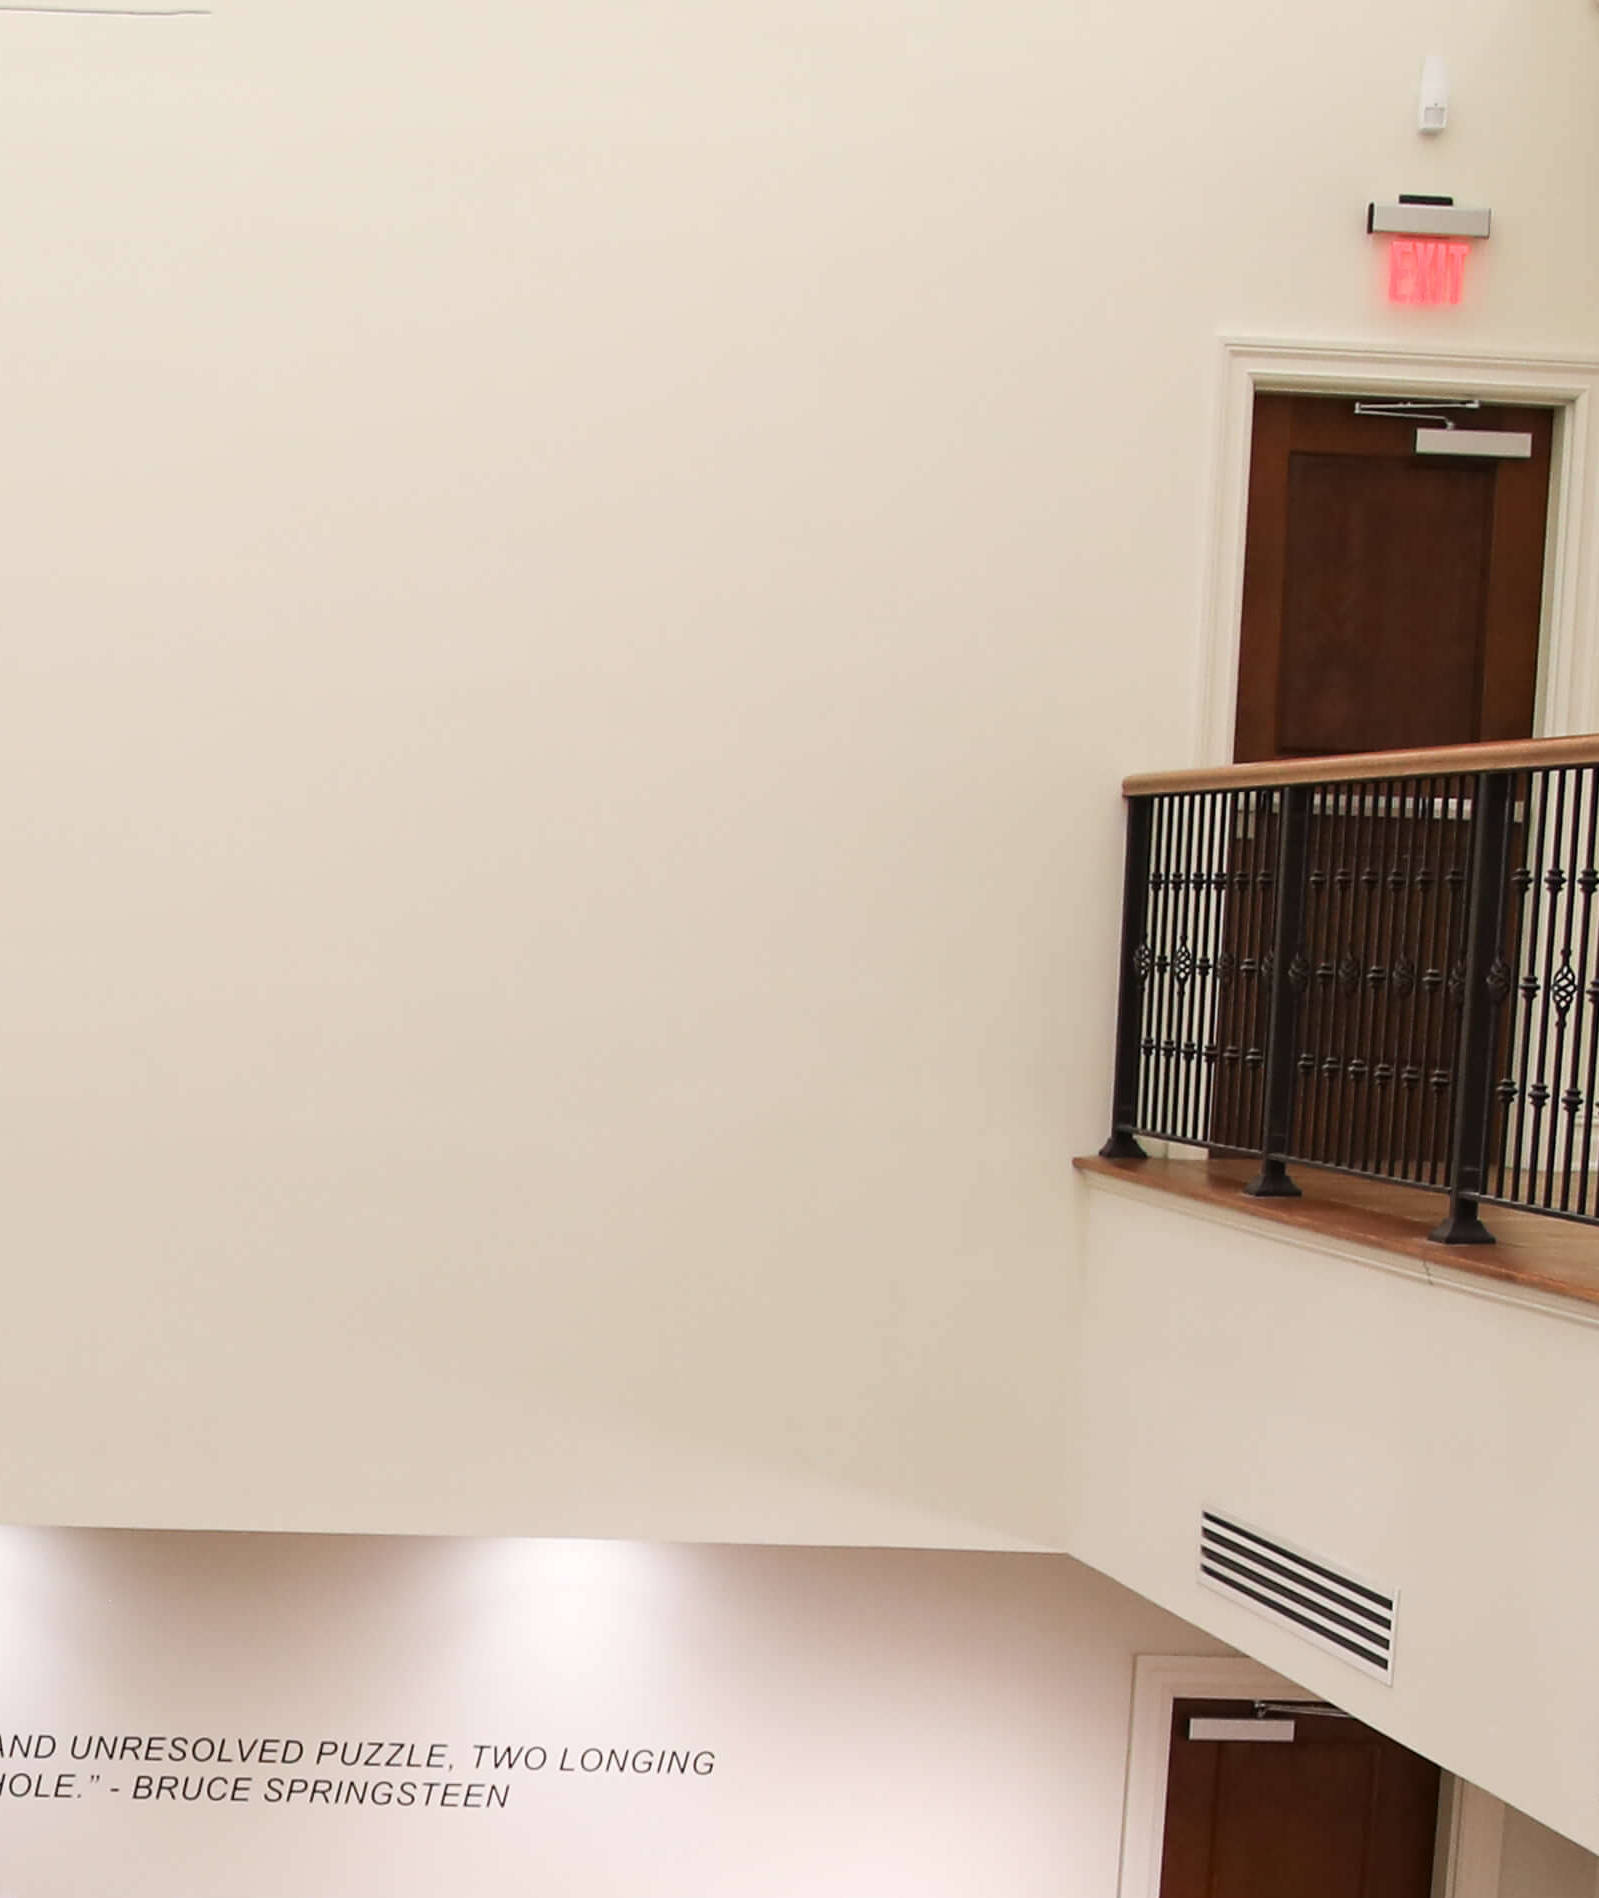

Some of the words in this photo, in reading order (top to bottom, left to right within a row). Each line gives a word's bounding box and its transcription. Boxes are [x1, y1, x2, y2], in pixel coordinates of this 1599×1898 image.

[1389, 240, 1470, 304] EXIT
[70, 1735, 304, 1765] UNRESOLVED
[315, 1740, 454, 1772] PUZZLE,
[472, 1744, 548, 1771] TWO
[558, 1746, 716, 1776] LONGING
[131, 1775, 253, 1803] BRUCE
[263, 1777, 511, 1809] SPRINGSTEEN
